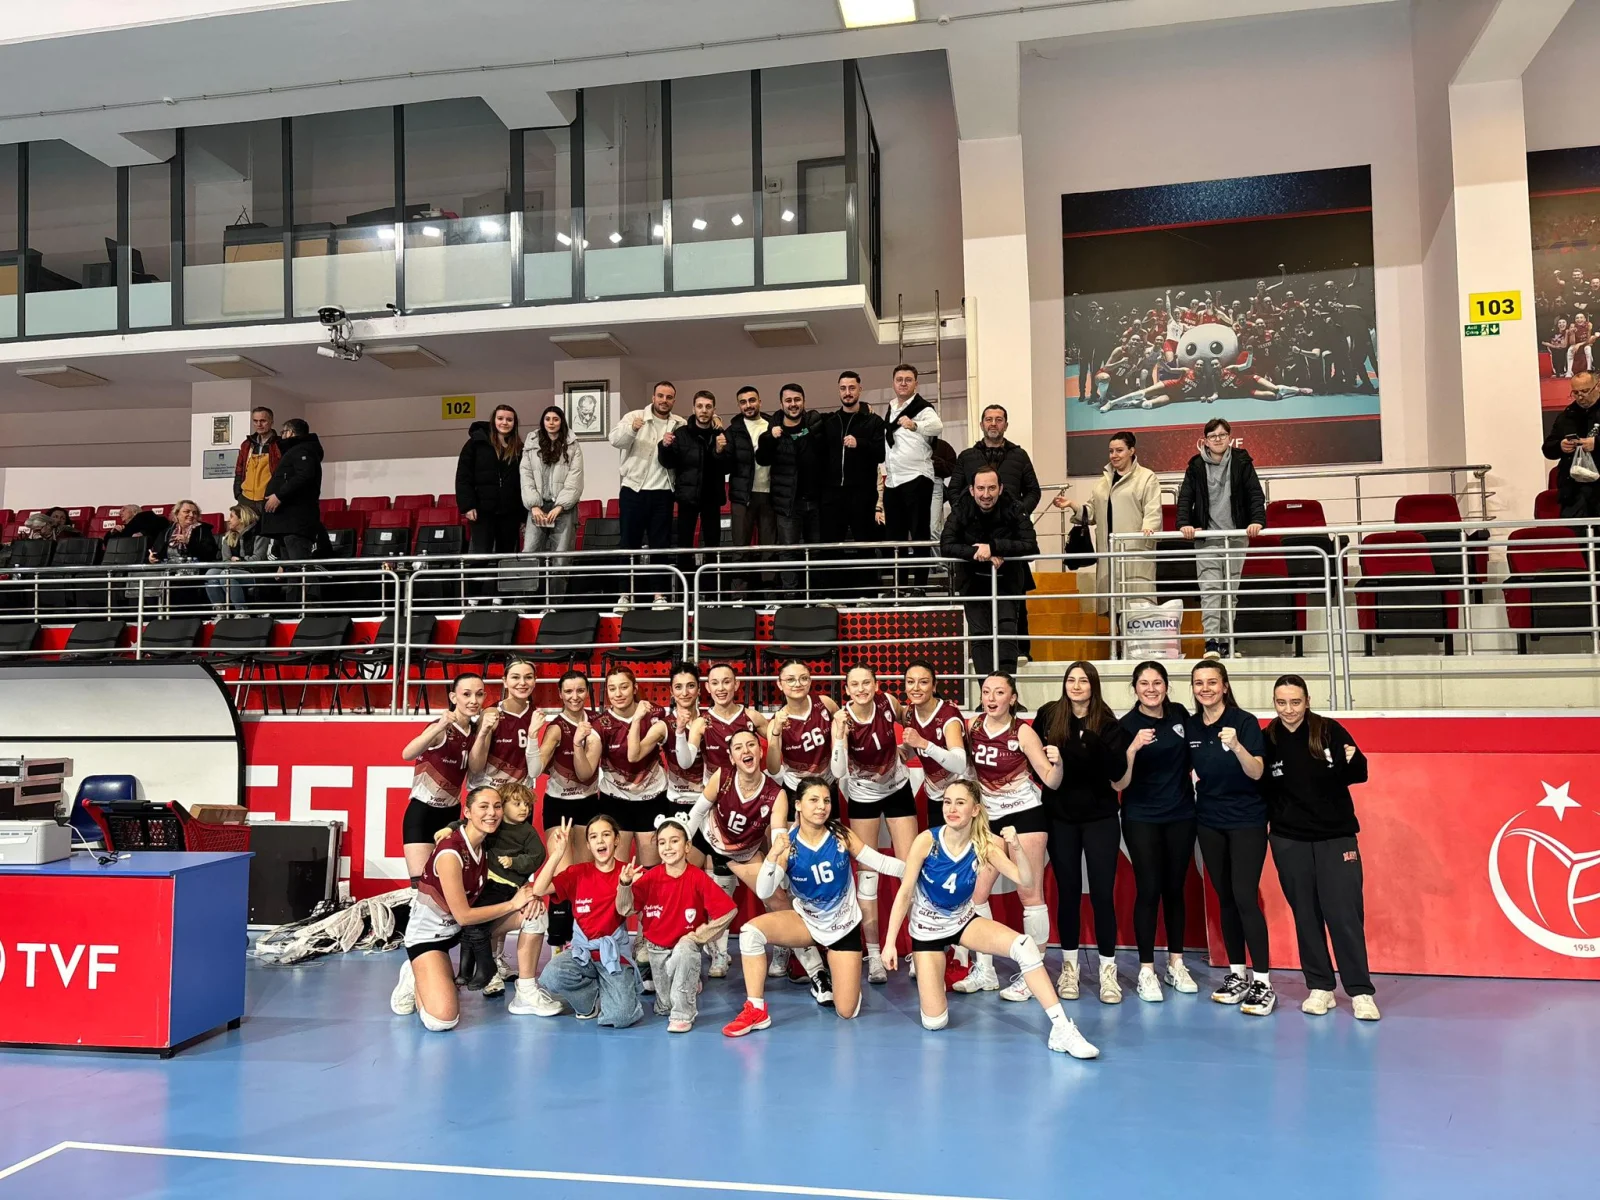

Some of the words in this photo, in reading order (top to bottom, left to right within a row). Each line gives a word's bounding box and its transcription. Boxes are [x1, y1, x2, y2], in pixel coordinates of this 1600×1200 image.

[1477, 299, 1515, 316] 103
[446, 402, 471, 415] 102
[1127, 620, 1141, 629] LC
[517, 728, 527, 748] 6
[801, 727, 825, 752] 26
[871, 732, 881, 750] 1
[975, 744, 998, 766] 22
[727, 810, 747, 833] 12
[810, 860, 835, 885] 16
[941, 872, 957, 894] 4
[1573, 944, 1596, 952] 1958
[17, 943, 120, 990] TVF
